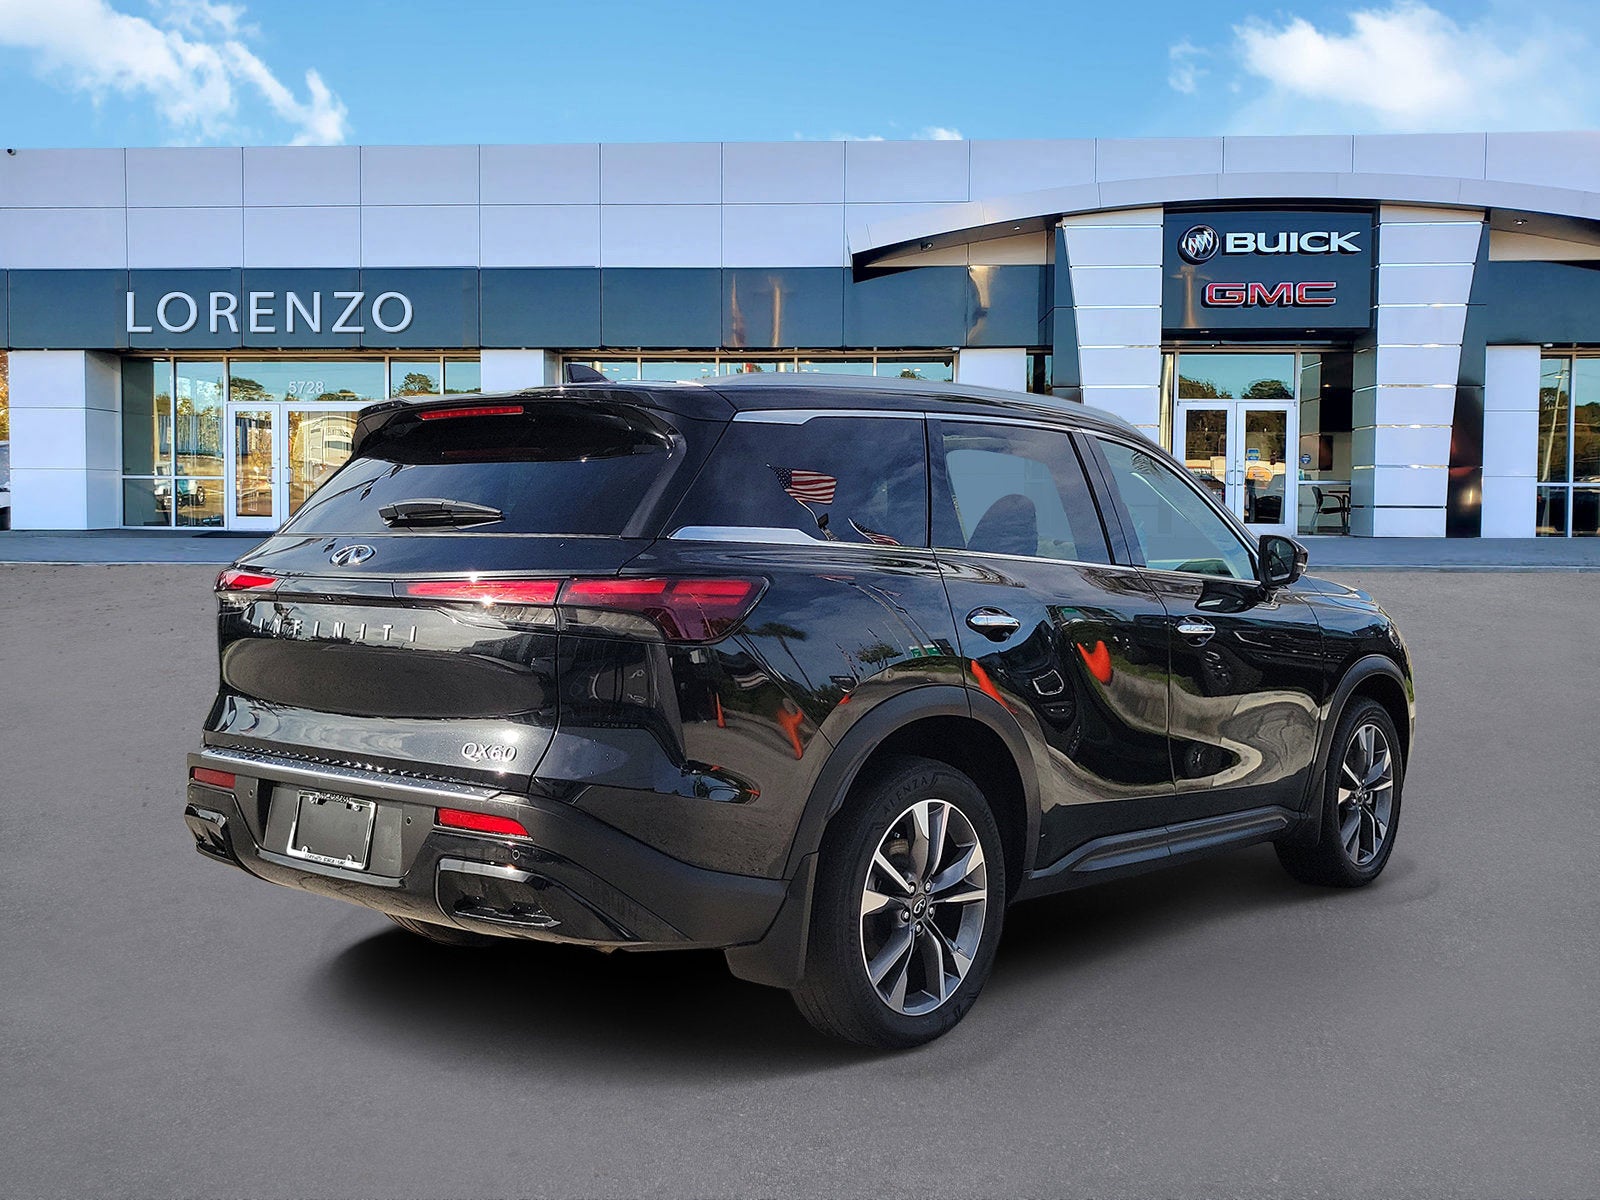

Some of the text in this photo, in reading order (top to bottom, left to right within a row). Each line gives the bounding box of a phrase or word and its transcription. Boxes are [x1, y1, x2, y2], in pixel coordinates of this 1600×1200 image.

[1225, 231, 1362, 253] BUICK
[1205, 281, 1337, 306] GMC
[126, 290, 413, 334] LORENZO
[288, 380, 325, 395] 5728
[257, 617, 419, 643] INFINITI
[460, 741, 519, 763] QX60
